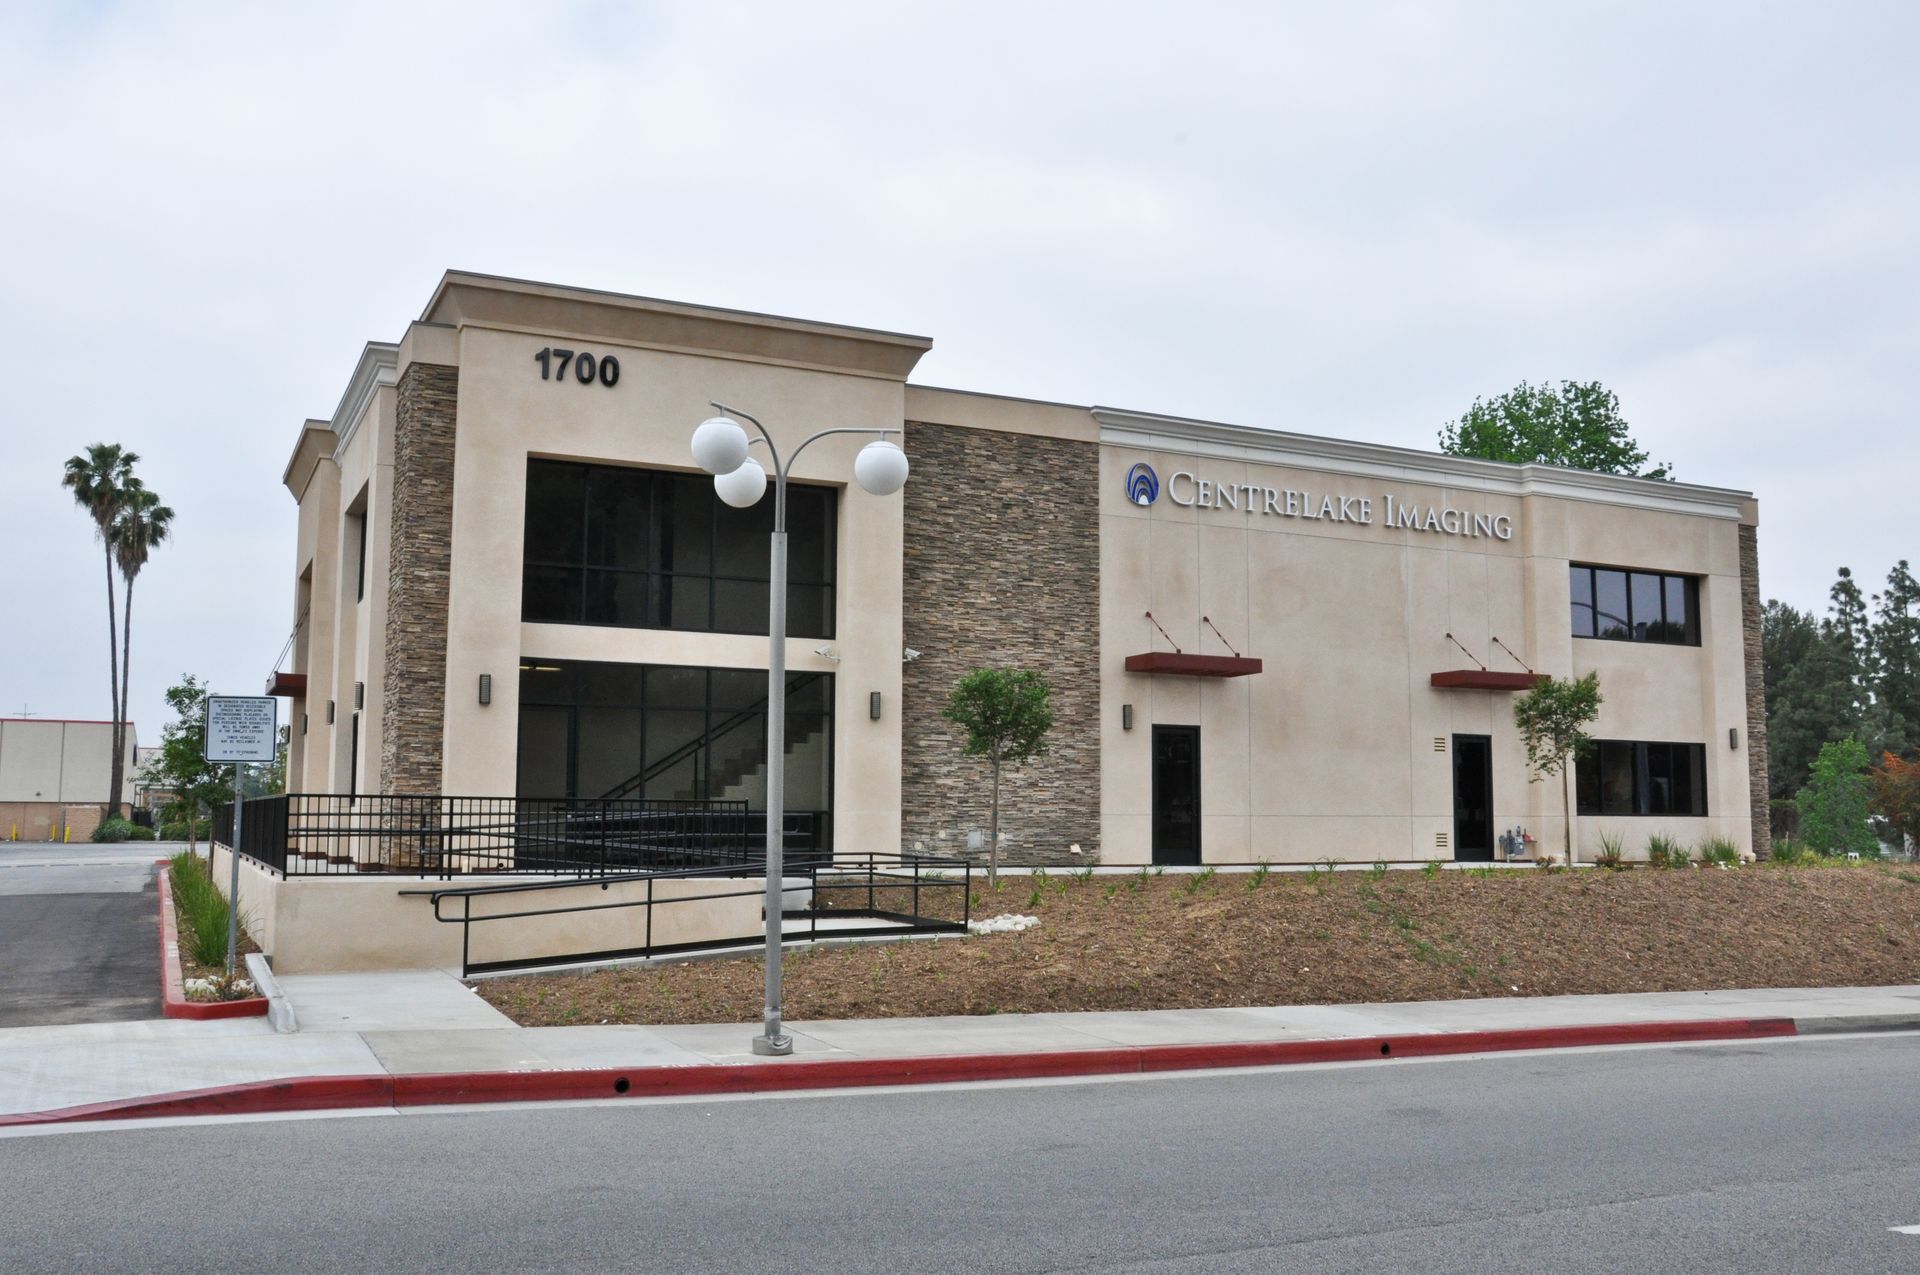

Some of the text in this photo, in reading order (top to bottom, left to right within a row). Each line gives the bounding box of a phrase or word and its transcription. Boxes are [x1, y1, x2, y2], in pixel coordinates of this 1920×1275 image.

[534, 347, 620, 387] 1700
[1168, 471, 1513, 540] CENTRELAKE IMAGING
